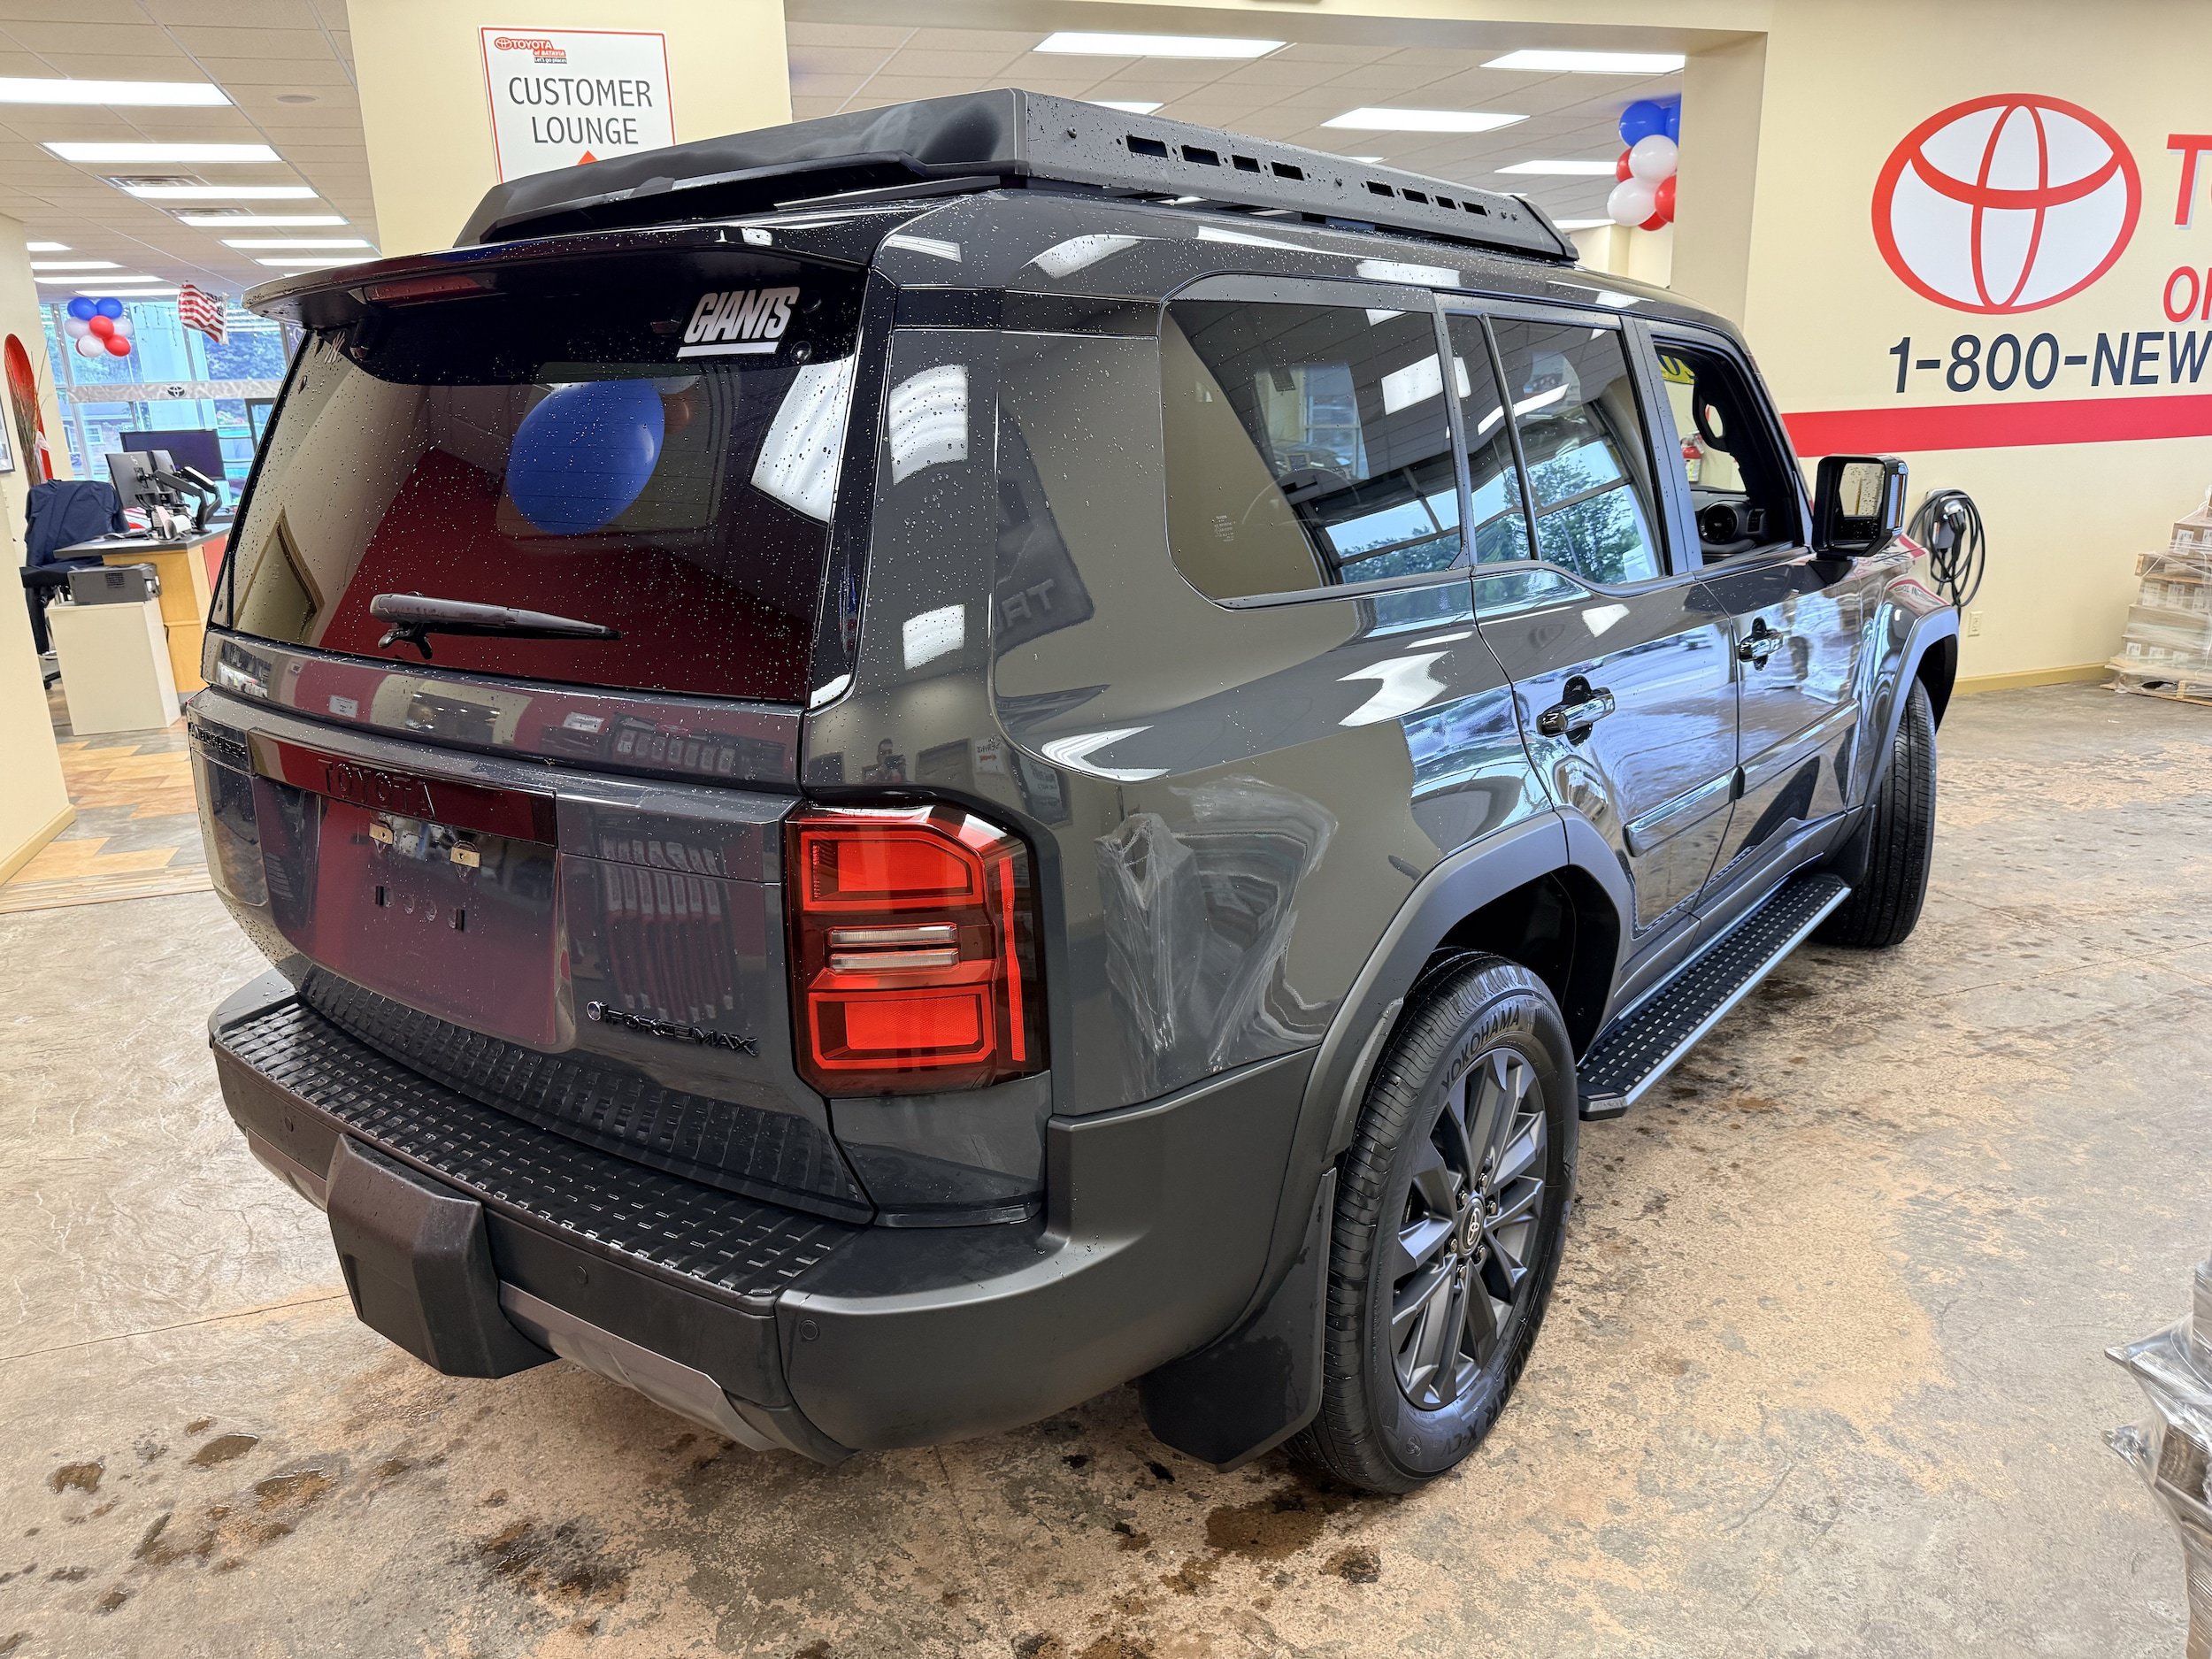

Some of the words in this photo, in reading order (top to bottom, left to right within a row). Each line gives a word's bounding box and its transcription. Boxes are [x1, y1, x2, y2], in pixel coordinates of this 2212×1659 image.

[511, 40, 552, 50] TOYOTA
[509, 77, 653, 107] CUSTOMER
[532, 116, 639, 145] LOUNGE
[2167, 134, 2212, 226] T
[683, 287, 800, 343] GIANTS
[1889, 330, 2212, 394] 1-800-NEW
[318, 758, 436, 818] TOYOTA
[693, 1026, 759, 1057] MAX
[1440, 1004, 1520, 1092] YOKOHAMA
